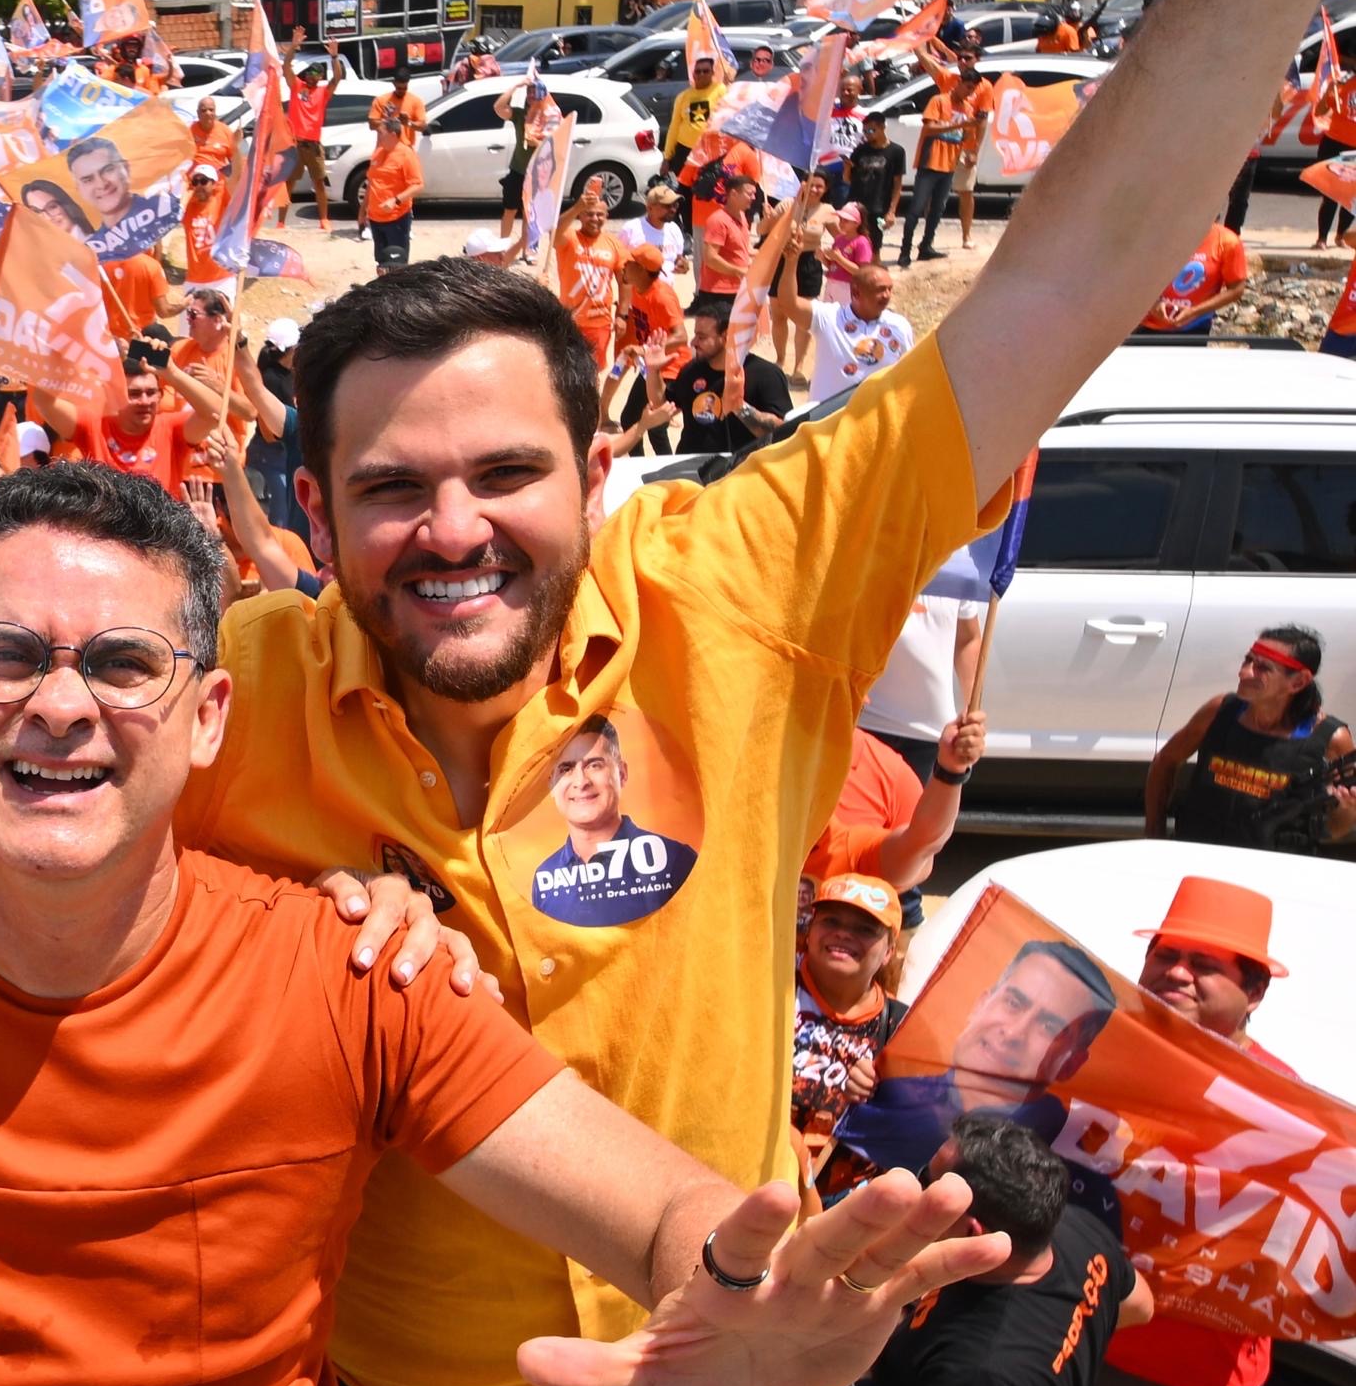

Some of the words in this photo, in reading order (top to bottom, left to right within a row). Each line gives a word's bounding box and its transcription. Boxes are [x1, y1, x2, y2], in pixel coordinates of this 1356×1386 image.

[86, 209, 156, 254] DAVID
[536, 862, 605, 892] DAVID
[596, 834, 668, 880] 70
[540, 873, 671, 899] GOVERNADOR
[1050, 1097, 1356, 1318] DAVID
